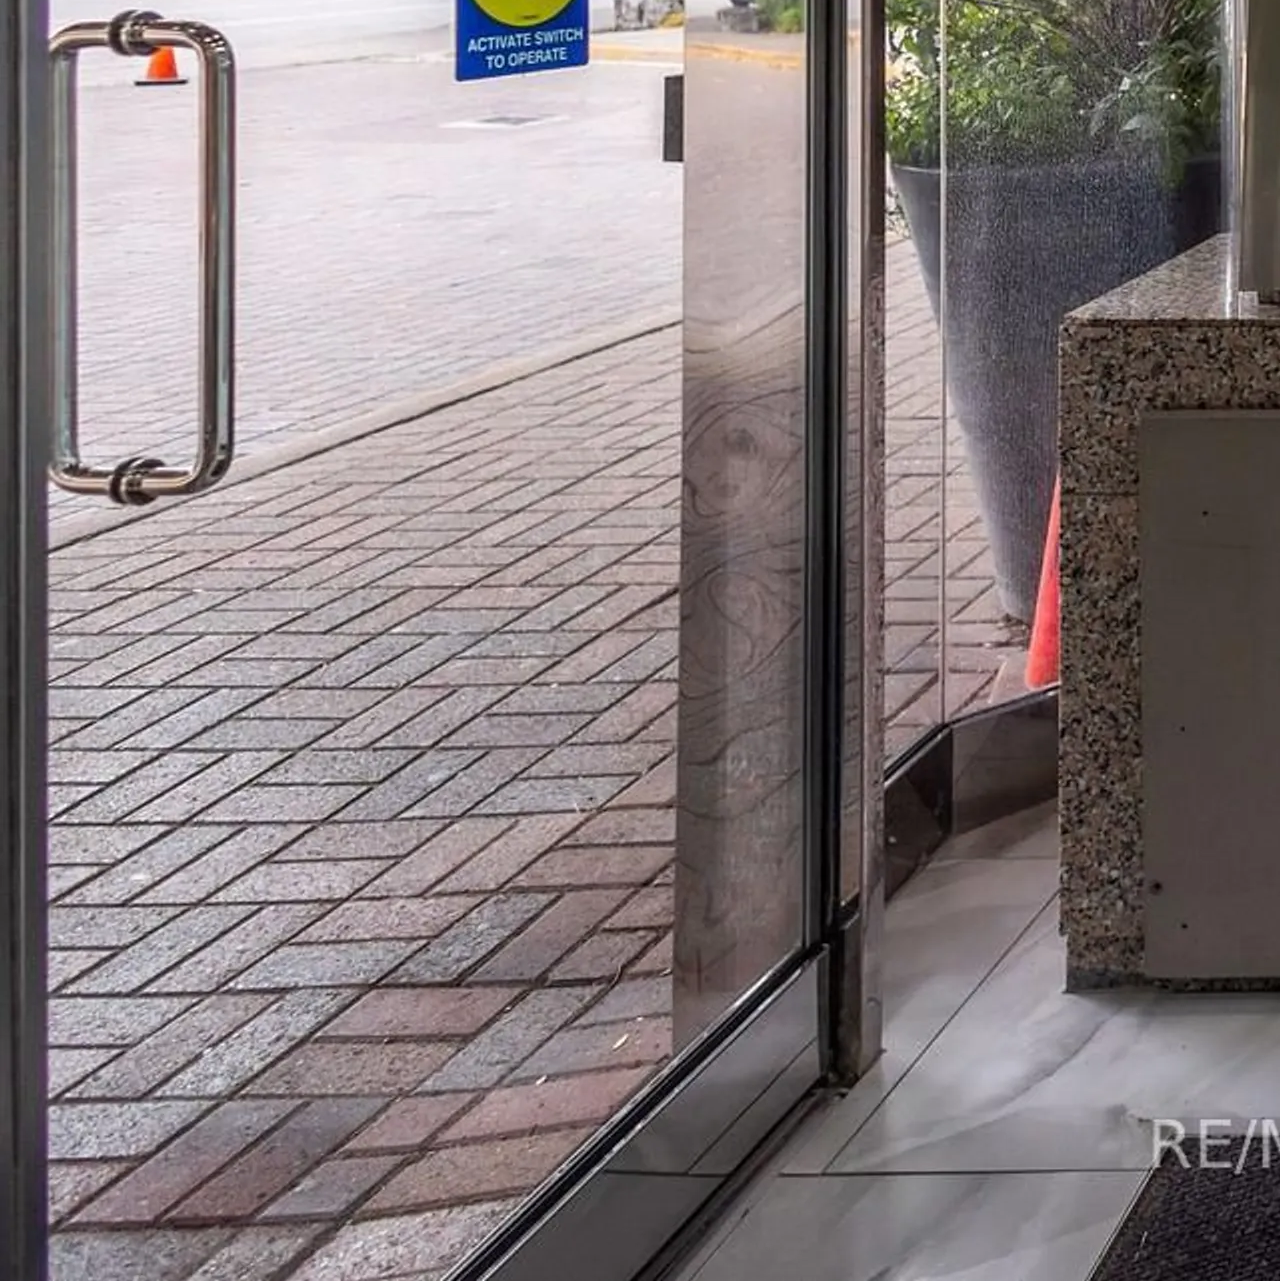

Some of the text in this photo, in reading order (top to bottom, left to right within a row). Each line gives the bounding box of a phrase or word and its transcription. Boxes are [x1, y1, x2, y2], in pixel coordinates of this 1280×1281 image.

[468, 27, 584, 52] ACTIVATE SWITCH
[485, 47, 568, 70] TO OPERATE
